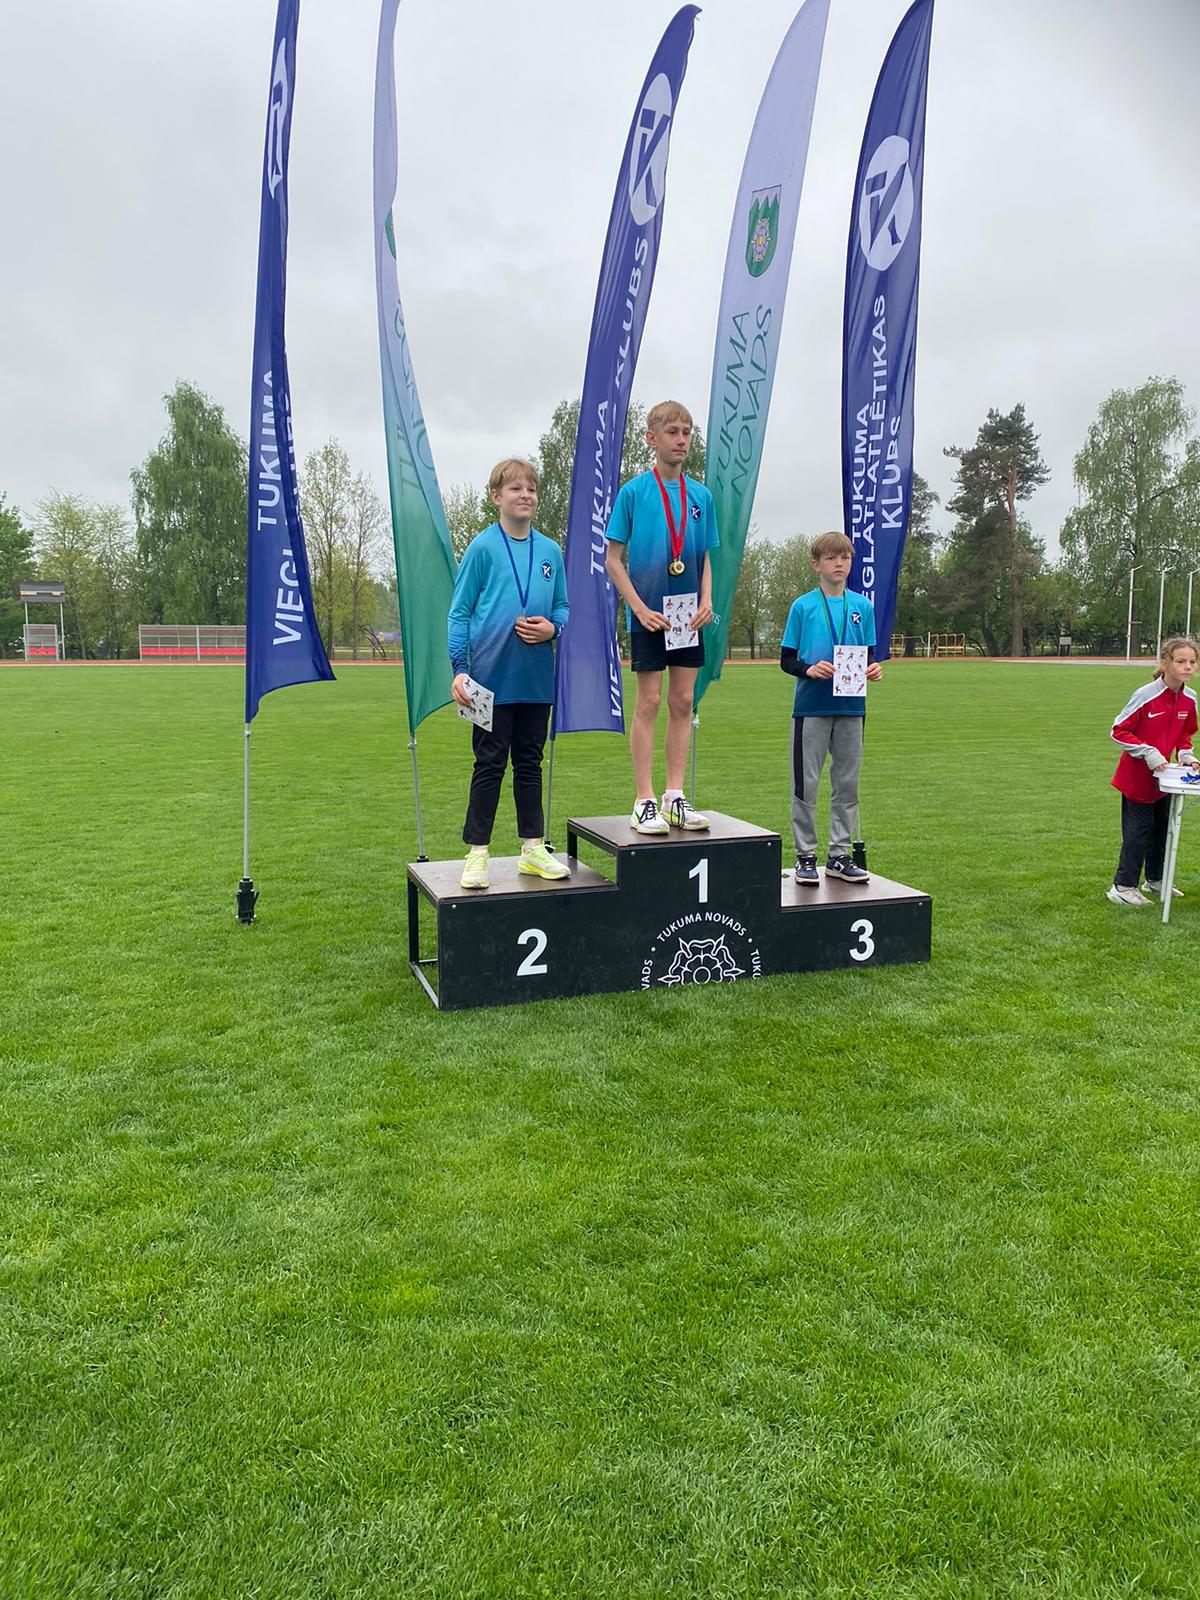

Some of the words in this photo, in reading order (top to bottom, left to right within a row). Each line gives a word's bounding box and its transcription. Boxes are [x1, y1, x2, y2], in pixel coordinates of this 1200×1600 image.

[615, 236, 649, 389] KLUBS
[715, 311, 750, 492] TUKUMA
[731, 304, 772, 498] NOVADS
[851, 403, 870, 544] TUKUMA
[881, 415, 903, 529] KLUBS
[656, 912, 703, 943] TUKUMA
[704, 911, 747, 937] NOVADS
[688, 858, 709, 903] 1
[516, 927, 548, 977] 2
[849, 918, 875, 961] 3
